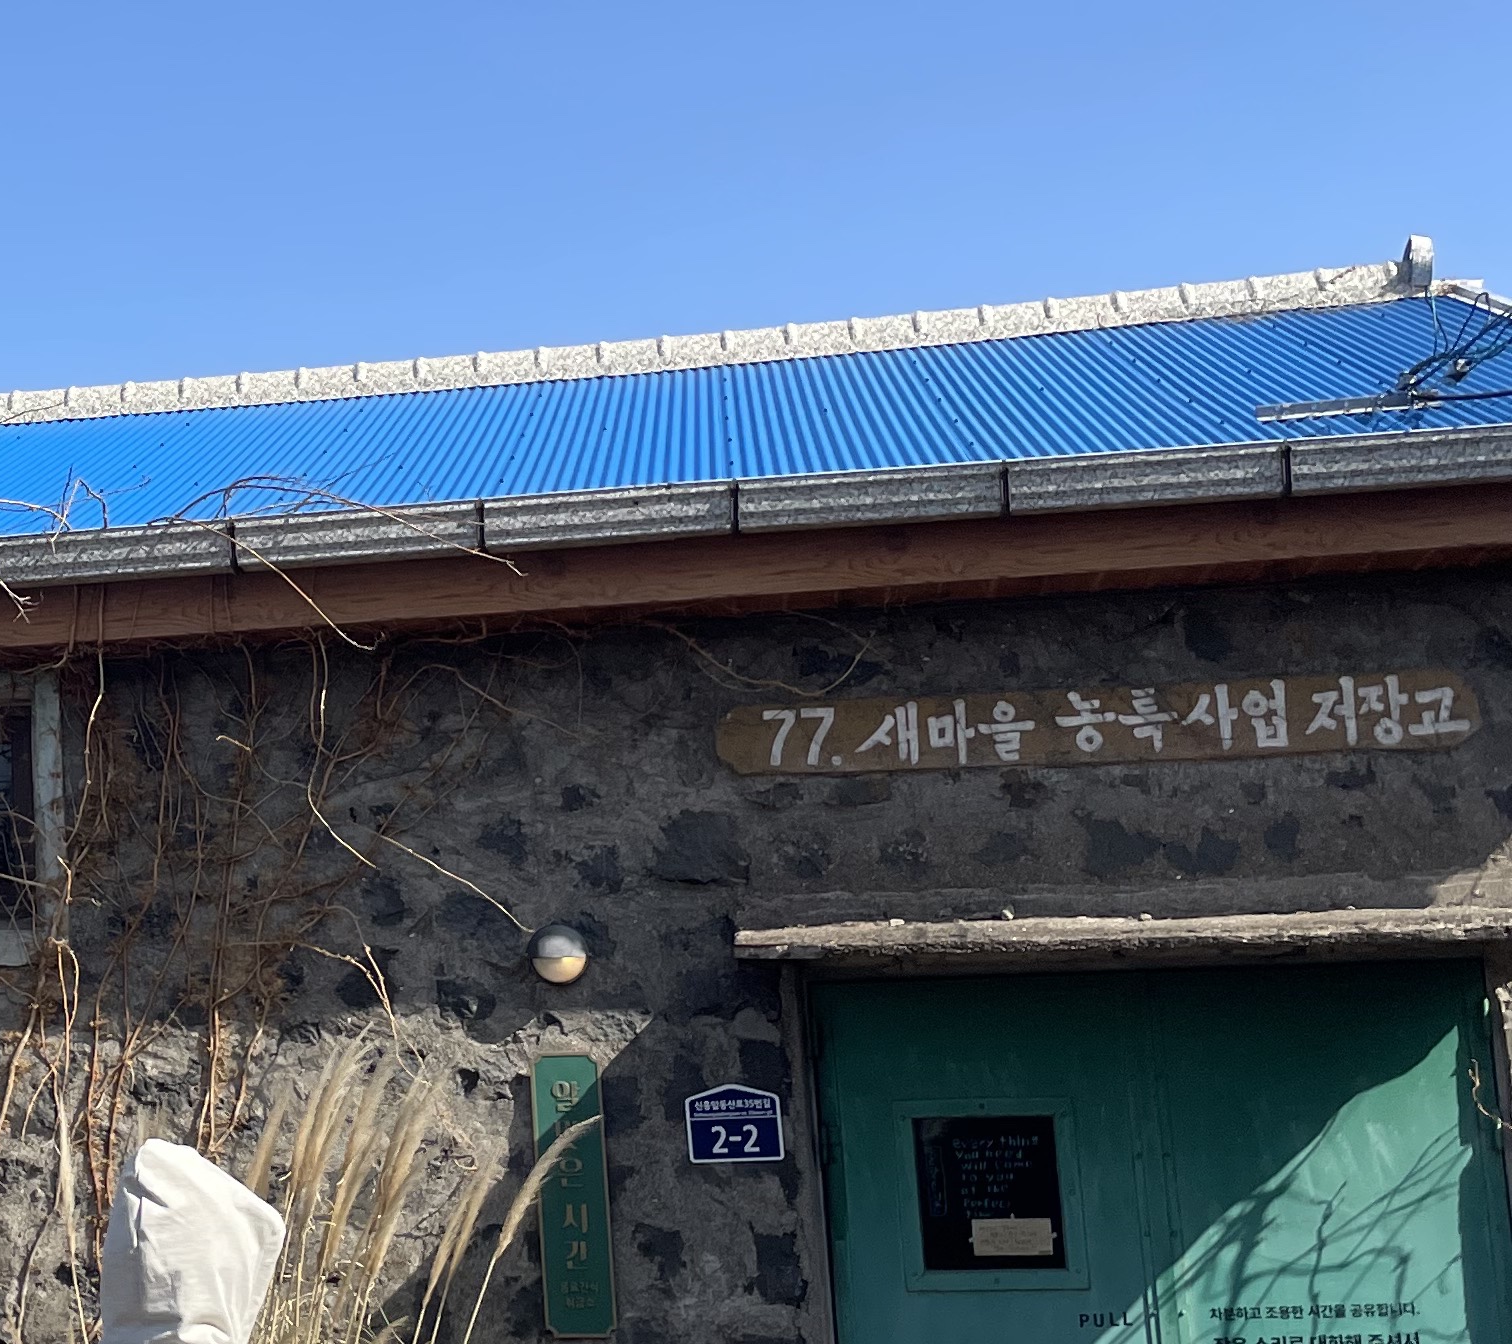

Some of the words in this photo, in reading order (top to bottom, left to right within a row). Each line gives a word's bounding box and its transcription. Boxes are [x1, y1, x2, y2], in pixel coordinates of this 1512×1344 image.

[762, 707, 842, 766] 77.
[854, 699, 1036, 765] 새마을
[1305, 674, 1471, 746] 저장고
[711, 1124, 761, 1154] 2-2
[1079, 1311, 1134, 1328] PULL
[1209, 1307, 1262, 1321] 차분하고
[1265, 1305, 1304, 1320] 조용한
[1308, 1304, 1347, 1319] 시간을
